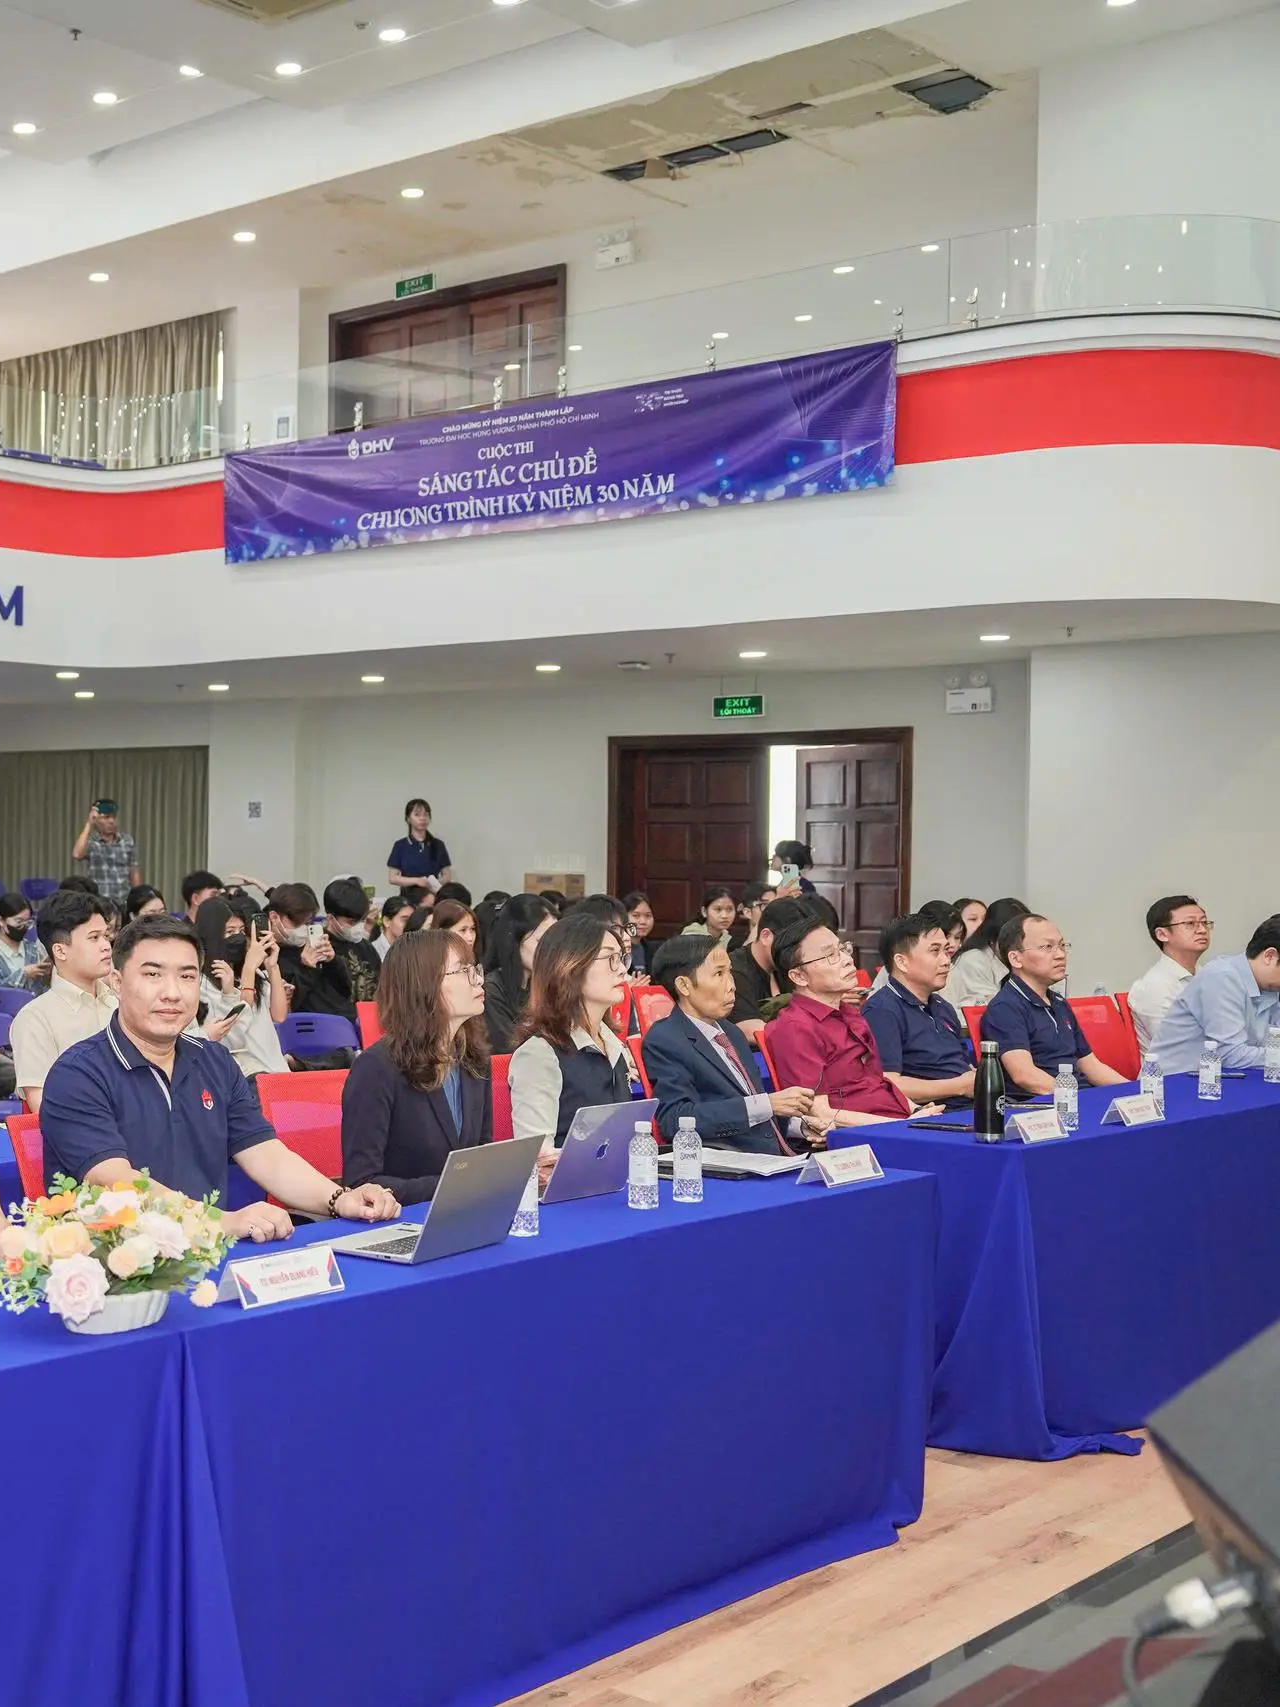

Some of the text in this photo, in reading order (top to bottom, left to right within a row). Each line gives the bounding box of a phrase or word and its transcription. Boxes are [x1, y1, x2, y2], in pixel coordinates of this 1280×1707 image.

[362, 436, 395, 454] DHV
[477, 440, 534, 460] CUỘC THI
[418, 446, 598, 497] SÁNG TÁC CHỦ ĐỀ
[356, 472, 676, 531] CHƯƠNG TRÌNH KỶ NIỆM 30 NĂM
[725, 698, 750, 707] EXIT
